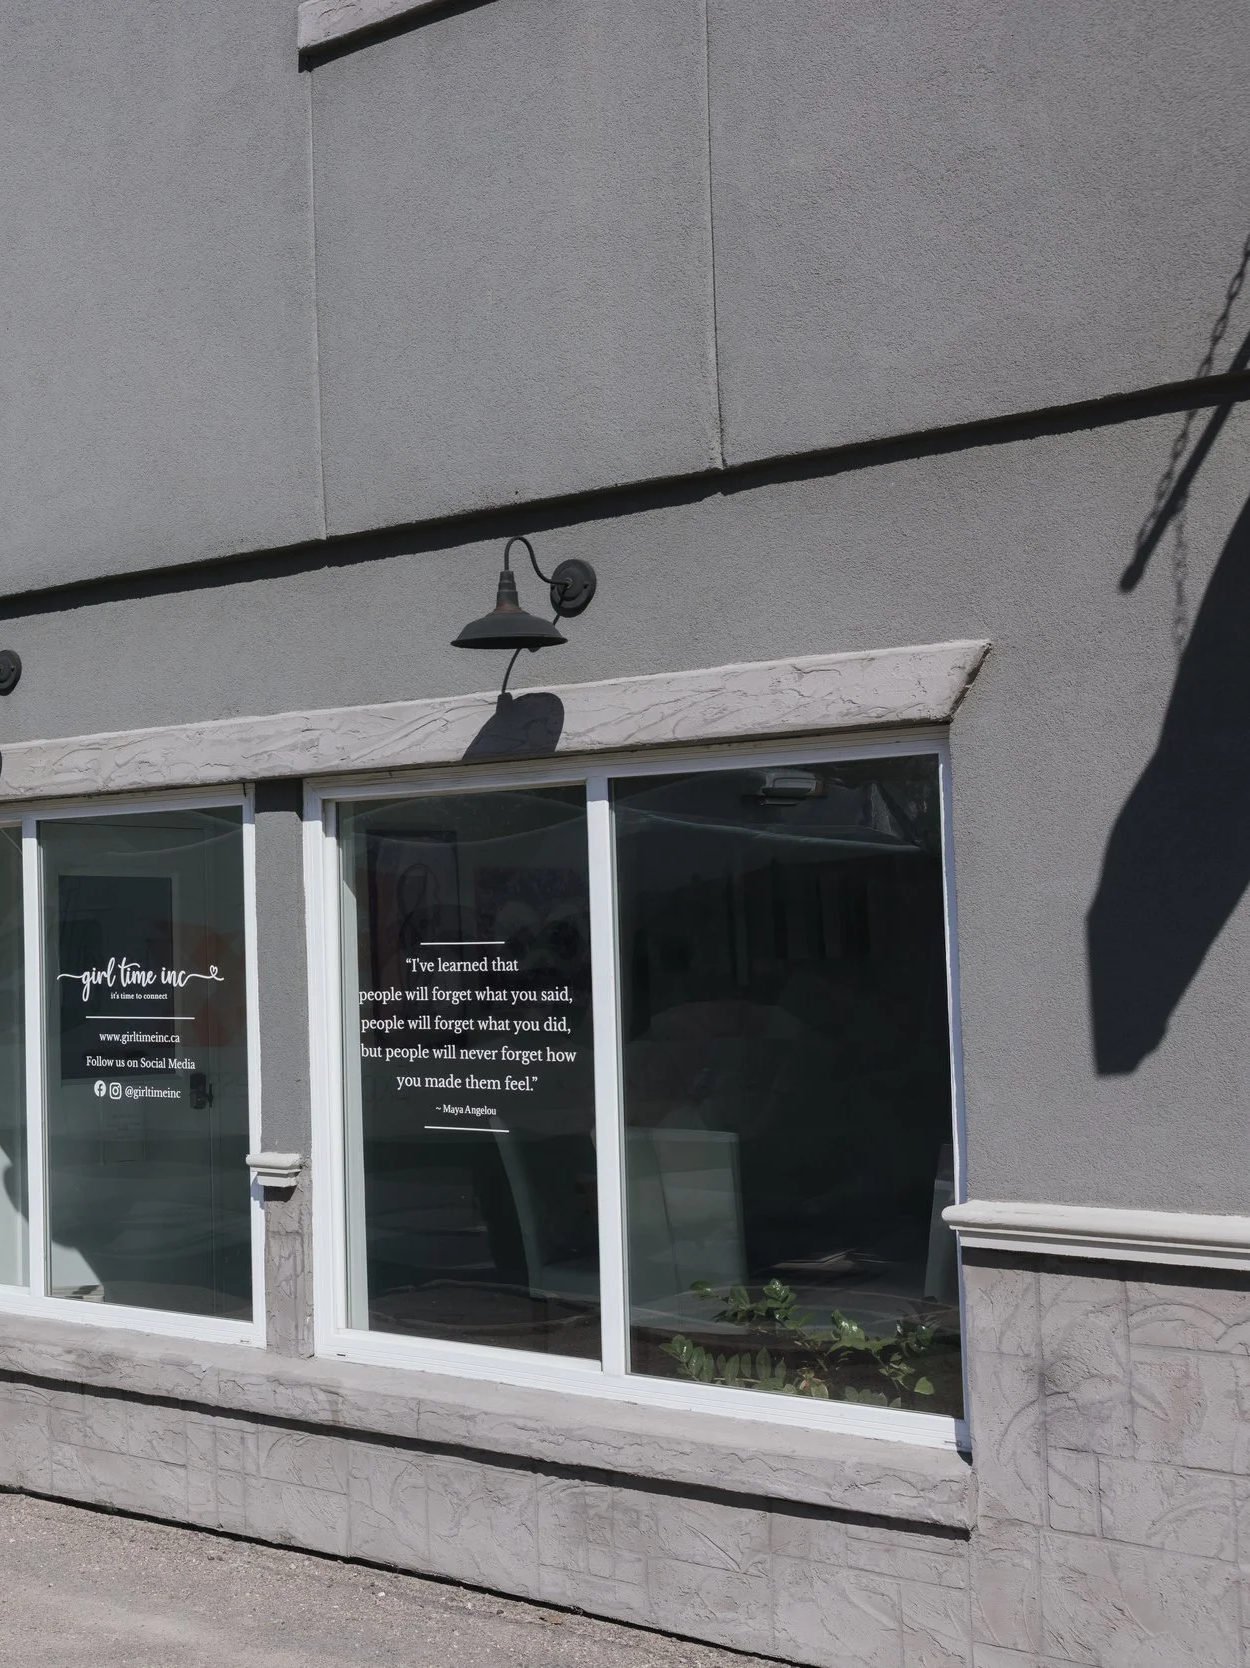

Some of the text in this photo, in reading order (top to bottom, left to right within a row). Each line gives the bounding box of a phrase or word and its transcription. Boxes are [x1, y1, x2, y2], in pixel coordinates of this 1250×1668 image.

[438, 957, 488, 972] learned
[492, 956, 519, 972] that
[57, 957, 116, 1002] girl
[118, 957, 157, 988] time
[111, 992, 119, 1000] it's
[121, 992, 135, 1000] time
[359, 986, 573, 1006] people will forget what you said,
[361, 1015, 571, 1035] people will forget what you did,
[99, 1031, 180, 1045] www.girltimeinc.ca
[86, 1055, 196, 1070] Follow us on Social Media
[361, 1044, 577, 1065] but people will never forget how
[397, 1076, 421, 1090] you
[425, 1074, 462, 1088] made
[465, 1074, 501, 1090] them
[125, 1085, 181, 1099] @girltimeinc
[443, 1104, 464, 1116] Maya
[464, 1104, 497, 1117] Angelou
